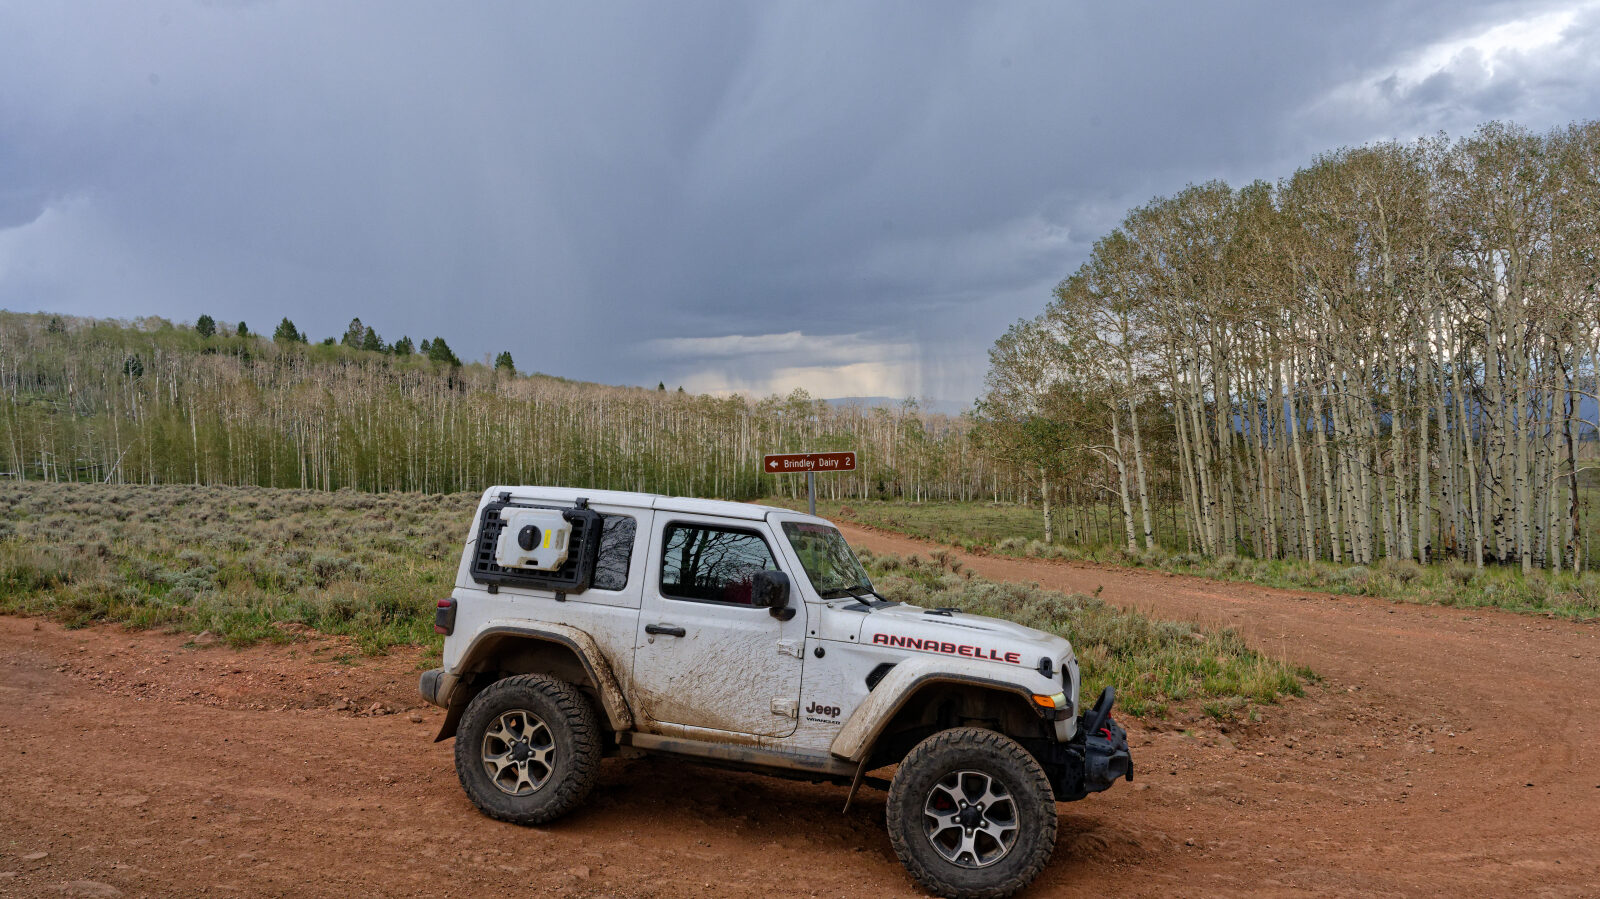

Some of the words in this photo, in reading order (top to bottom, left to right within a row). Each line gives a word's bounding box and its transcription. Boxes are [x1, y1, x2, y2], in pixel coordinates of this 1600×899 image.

[784, 459, 815, 468] Brindley
[819, 458, 839, 468] Dairy
[845, 457, 851, 466] 2
[873, 633, 1021, 664] ANNABELLE
[805, 701, 841, 718] Jeep
